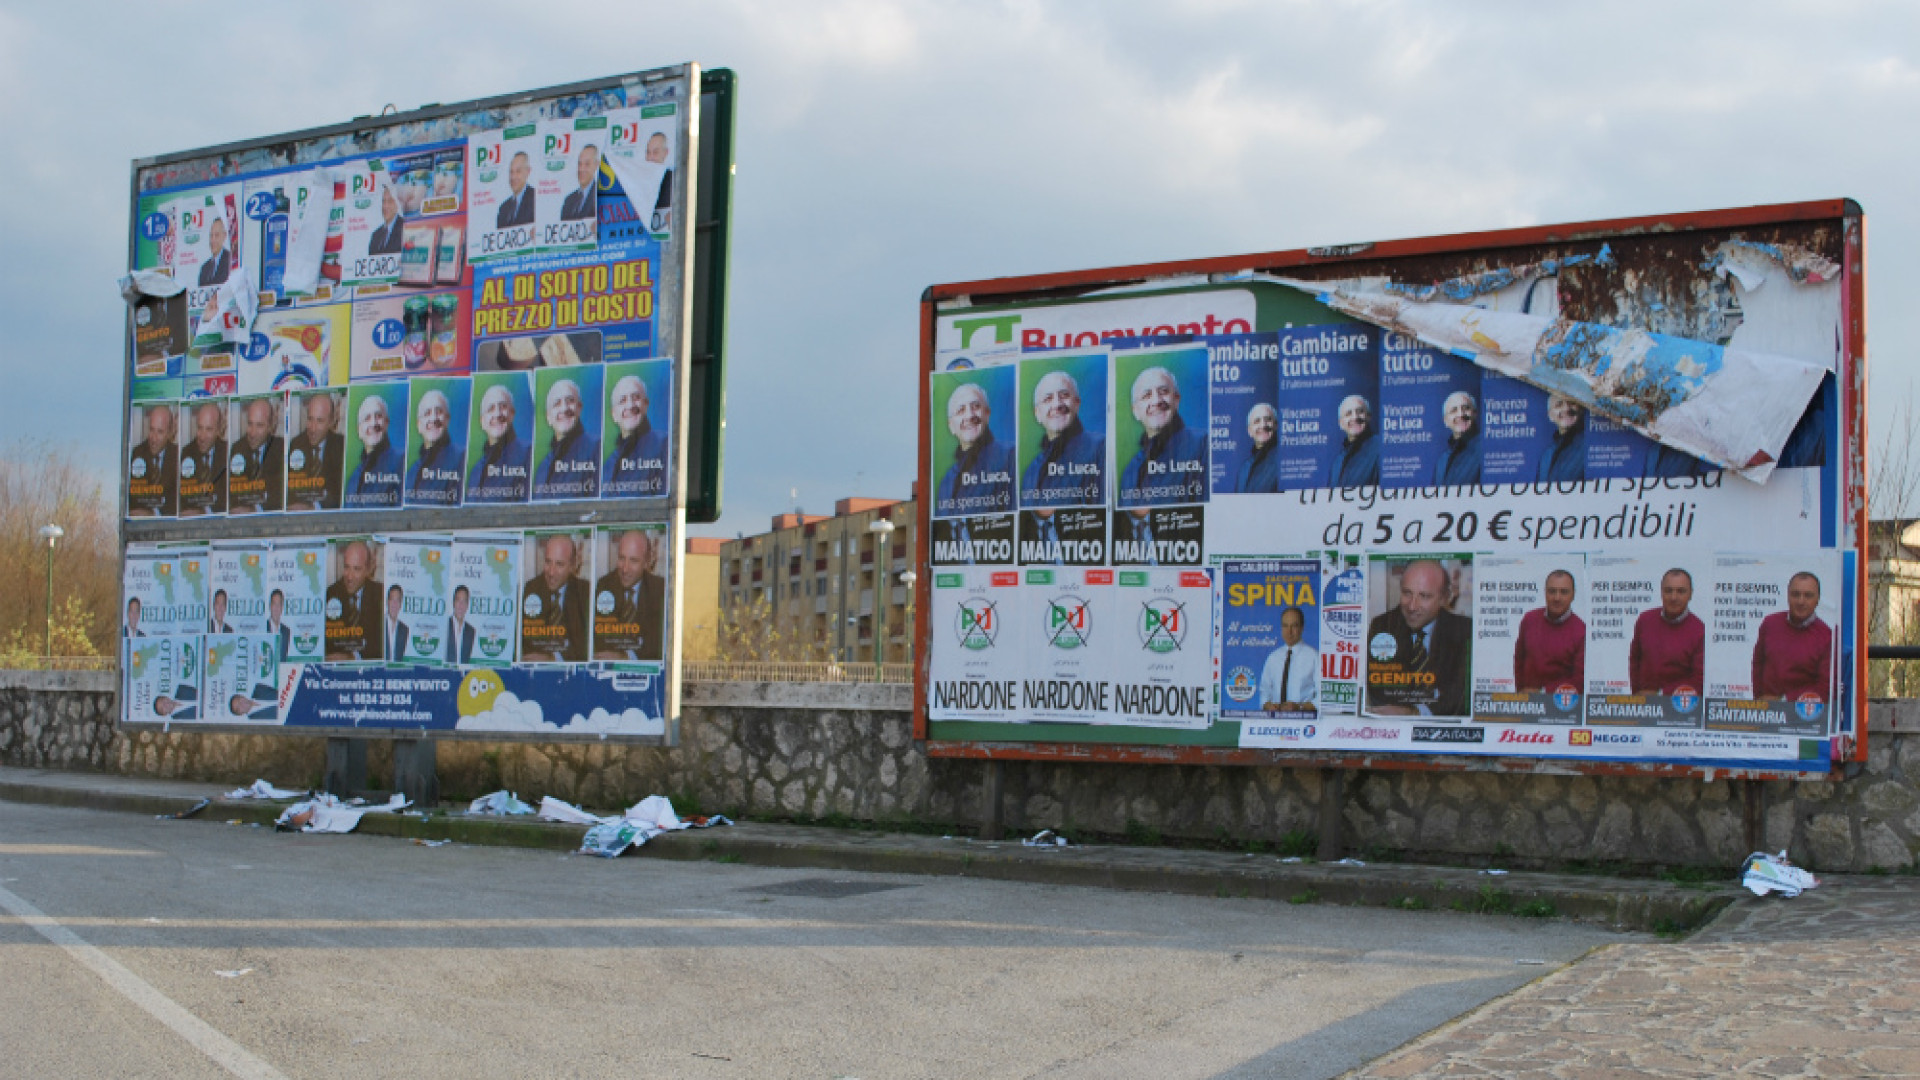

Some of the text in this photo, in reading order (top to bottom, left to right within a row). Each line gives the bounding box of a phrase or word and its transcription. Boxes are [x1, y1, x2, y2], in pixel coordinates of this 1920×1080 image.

[482, 278, 509, 306] AL
[514, 274, 535, 302] DI
[539, 265, 609, 299] SOTTO
[613, 259, 653, 291] DEL
[474, 290, 652, 336] PREZZO DI COSTO
[1209, 338, 1279, 362] ambiare
[1281, 331, 1368, 356] Cambiare
[1281, 354, 1329, 377] tutto
[1382, 351, 1433, 373] tutto
[1211, 363, 1241, 382] tto
[1383, 404, 1424, 417] Vincenzo
[1484, 398, 1527, 410] Vincenzo
[1281, 408, 1321, 419] Vincenzo
[1485, 411, 1527, 424] De Luca
[1281, 420, 1320, 433] De Luca
[1383, 417, 1423, 430] De Luca
[1383, 431, 1432, 444] Presidente
[1485, 425, 1537, 439] Presidente
[1281, 434, 1328, 446] Presidente
[1048, 461, 1101, 476] De Luca,
[1148, 459, 1204, 474] De Luca,
[962, 470, 1011, 486] De Luca,
[1322, 502, 1697, 548] da 5 a 20 € spendibili
[934, 539, 1011, 562] MAIATICO
[1020, 540, 1103, 563] MAIATICO
[1115, 540, 1199, 563] MAIATICO
[1480, 581, 1539, 593] PER ESEMPIO,
[1591, 581, 1653, 594] PER ESEMPIO,
[1714, 582, 1781, 596] PER ESEMPIO,
[1228, 583, 1316, 607] SPINA
[178, 603, 207, 621] ELLO
[228, 599, 266, 617] BELLO
[284, 598, 323, 616] BELLO
[403, 596, 446, 616] BELLO
[469, 596, 514, 616] BELLO
[326, 627, 363, 637] GENITO
[523, 626, 566, 636] GENITO
[595, 623, 640, 634] GENITO
[386, 679, 450, 691] BENEVENTO
[1370, 672, 1436, 684] GENITO
[934, 681, 1017, 710] NARDONE
[1023, 680, 1109, 711] NARDONE
[1115, 684, 1206, 718] NARDONE
[1474, 702, 1546, 715] SANTAMARIA
[1589, 704, 1664, 718] SANTAMARIA
[1708, 708, 1787, 724] SANTAMARIA
[1498, 729, 1554, 744] Bata
[1571, 731, 1642, 744] 50 NEGOZI
